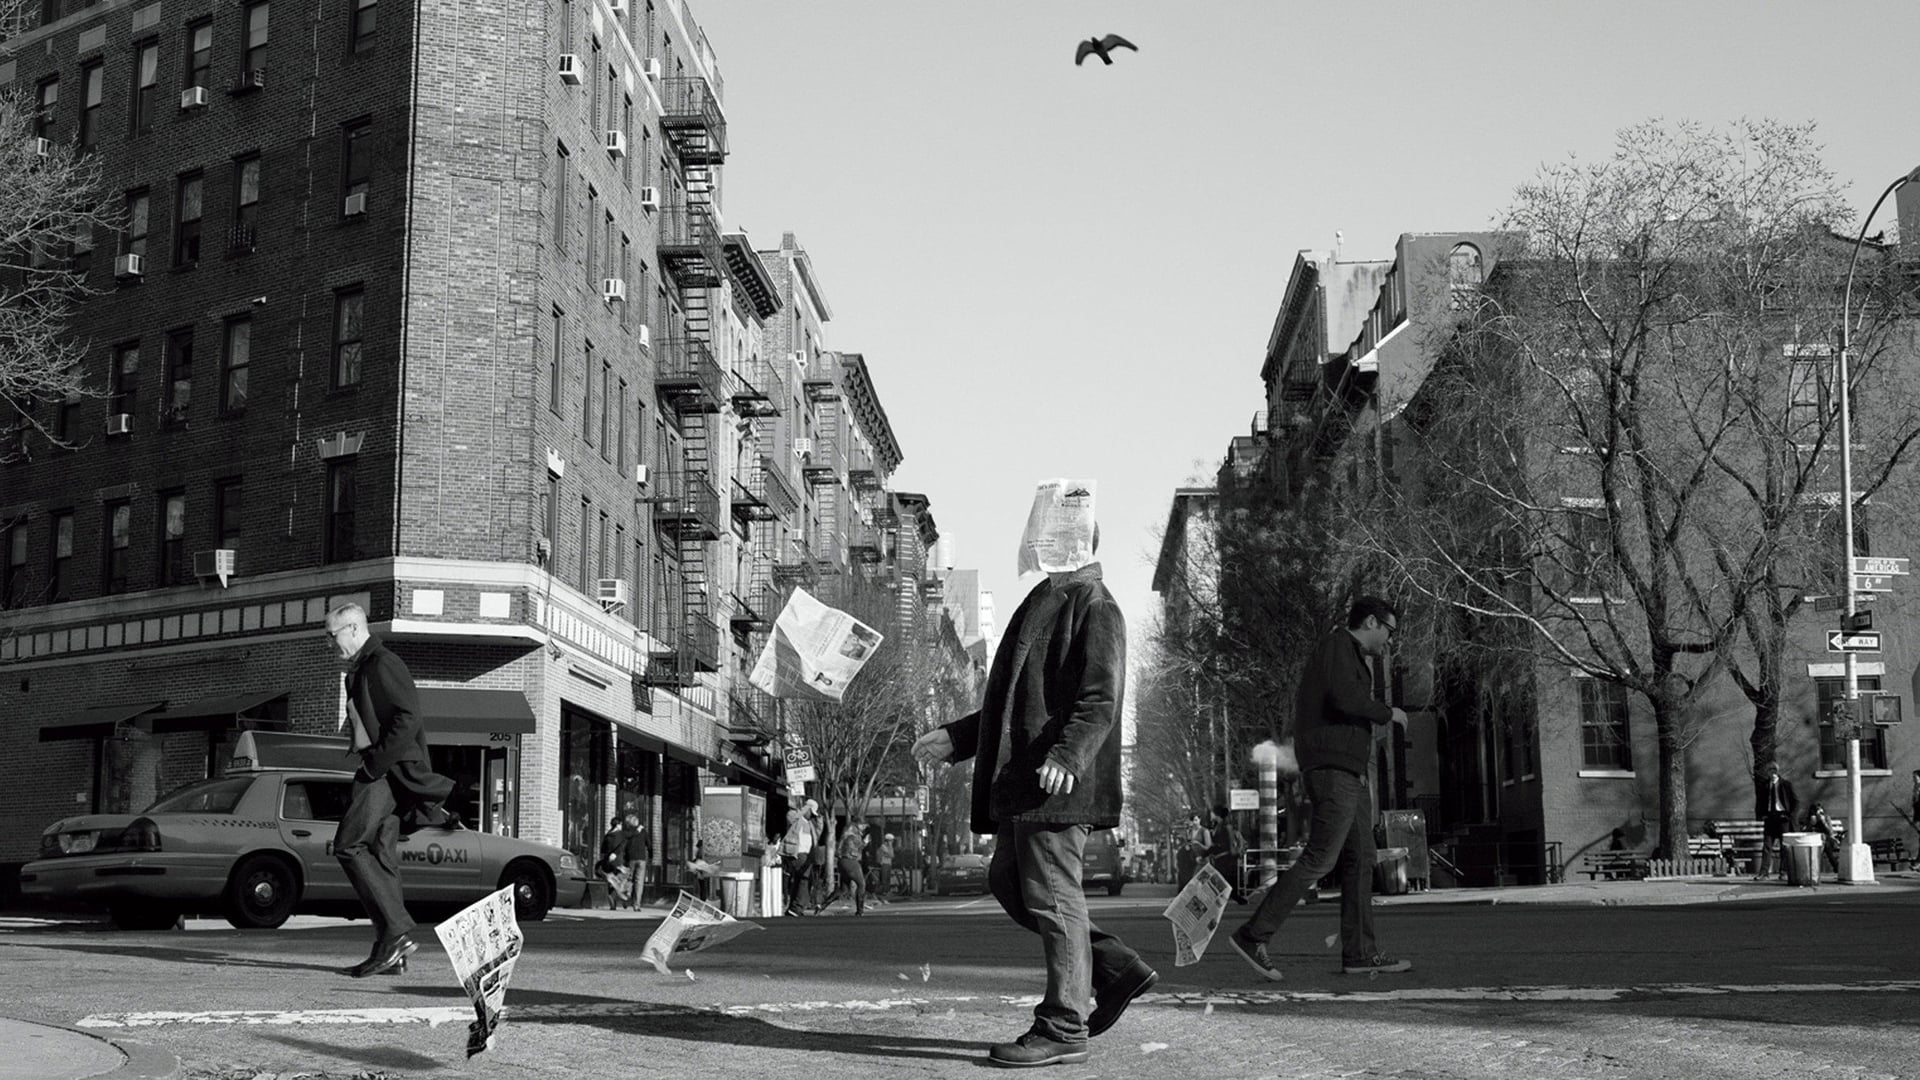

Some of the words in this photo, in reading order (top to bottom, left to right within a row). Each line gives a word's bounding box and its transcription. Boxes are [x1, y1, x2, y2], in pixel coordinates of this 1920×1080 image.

[1864, 578, 1872, 589] 6
[489, 732, 512, 742] 205
[402, 850, 426, 862] NYC
[428, 845, 468, 864] TAXI
